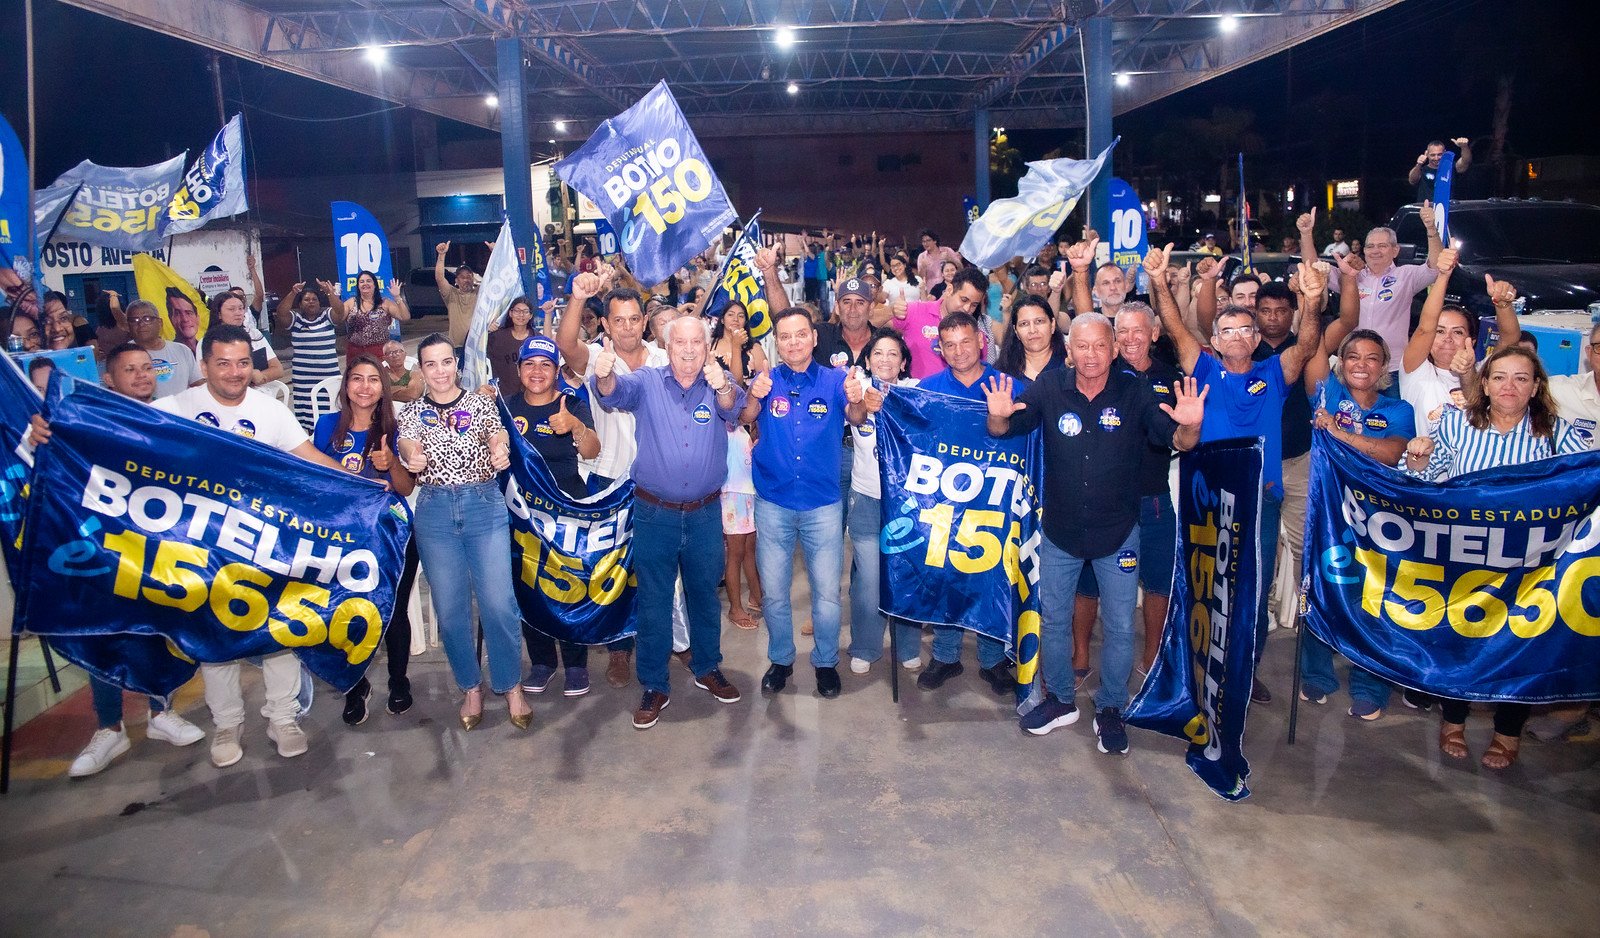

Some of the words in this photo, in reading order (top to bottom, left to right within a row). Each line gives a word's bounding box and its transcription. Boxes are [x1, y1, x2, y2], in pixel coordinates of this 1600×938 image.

[341, 233, 382, 275] 10
[600, 233, 616, 254] 10
[1112, 208, 1142, 250] 10
[81, 464, 380, 593] BOTELHO
[126, 460, 243, 502] DEPUTADO
[250, 497, 356, 543] ESTADUAL
[880, 497, 925, 554] é
[1341, 485, 1600, 569] BOTELHO
[1352, 488, 1459, 520] DEPUTADO
[1471, 503, 1589, 522] ESTADUAL
[48, 516, 111, 577] é
[103, 529, 383, 665] 15650
[514, 529, 637, 606] 156
[1321, 529, 1360, 585] é
[1355, 546, 1600, 639] 15650
[1203, 488, 1236, 762] BOTELHO
